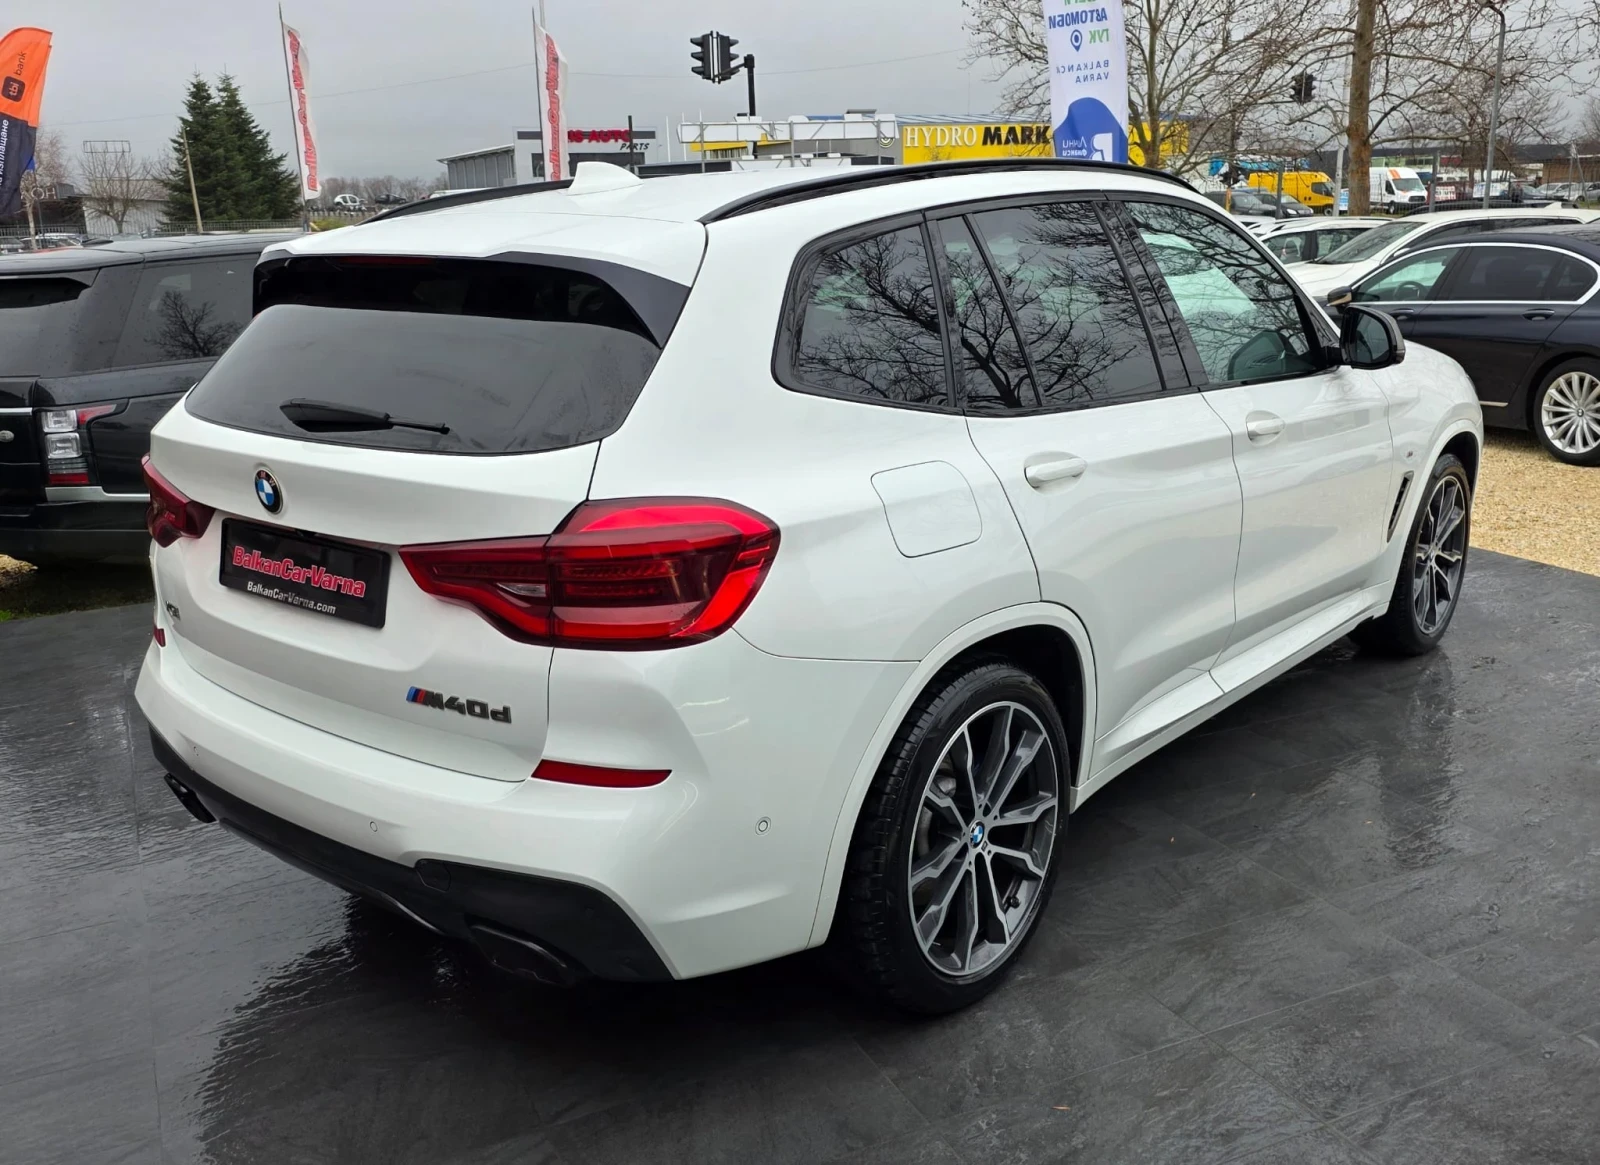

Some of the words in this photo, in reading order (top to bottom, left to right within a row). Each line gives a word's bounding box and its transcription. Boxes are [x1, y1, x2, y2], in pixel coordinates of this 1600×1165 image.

[14, 51, 27, 76] bank
[588, 130, 630, 143] AUTO
[905, 126, 977, 147] HYDRO
[982, 126, 1050, 146] MARK
[232, 546, 366, 598] BalkanCarVarna
[247, 581, 337, 614] BalkanCarVarna.com
[420, 690, 512, 724] M40d
